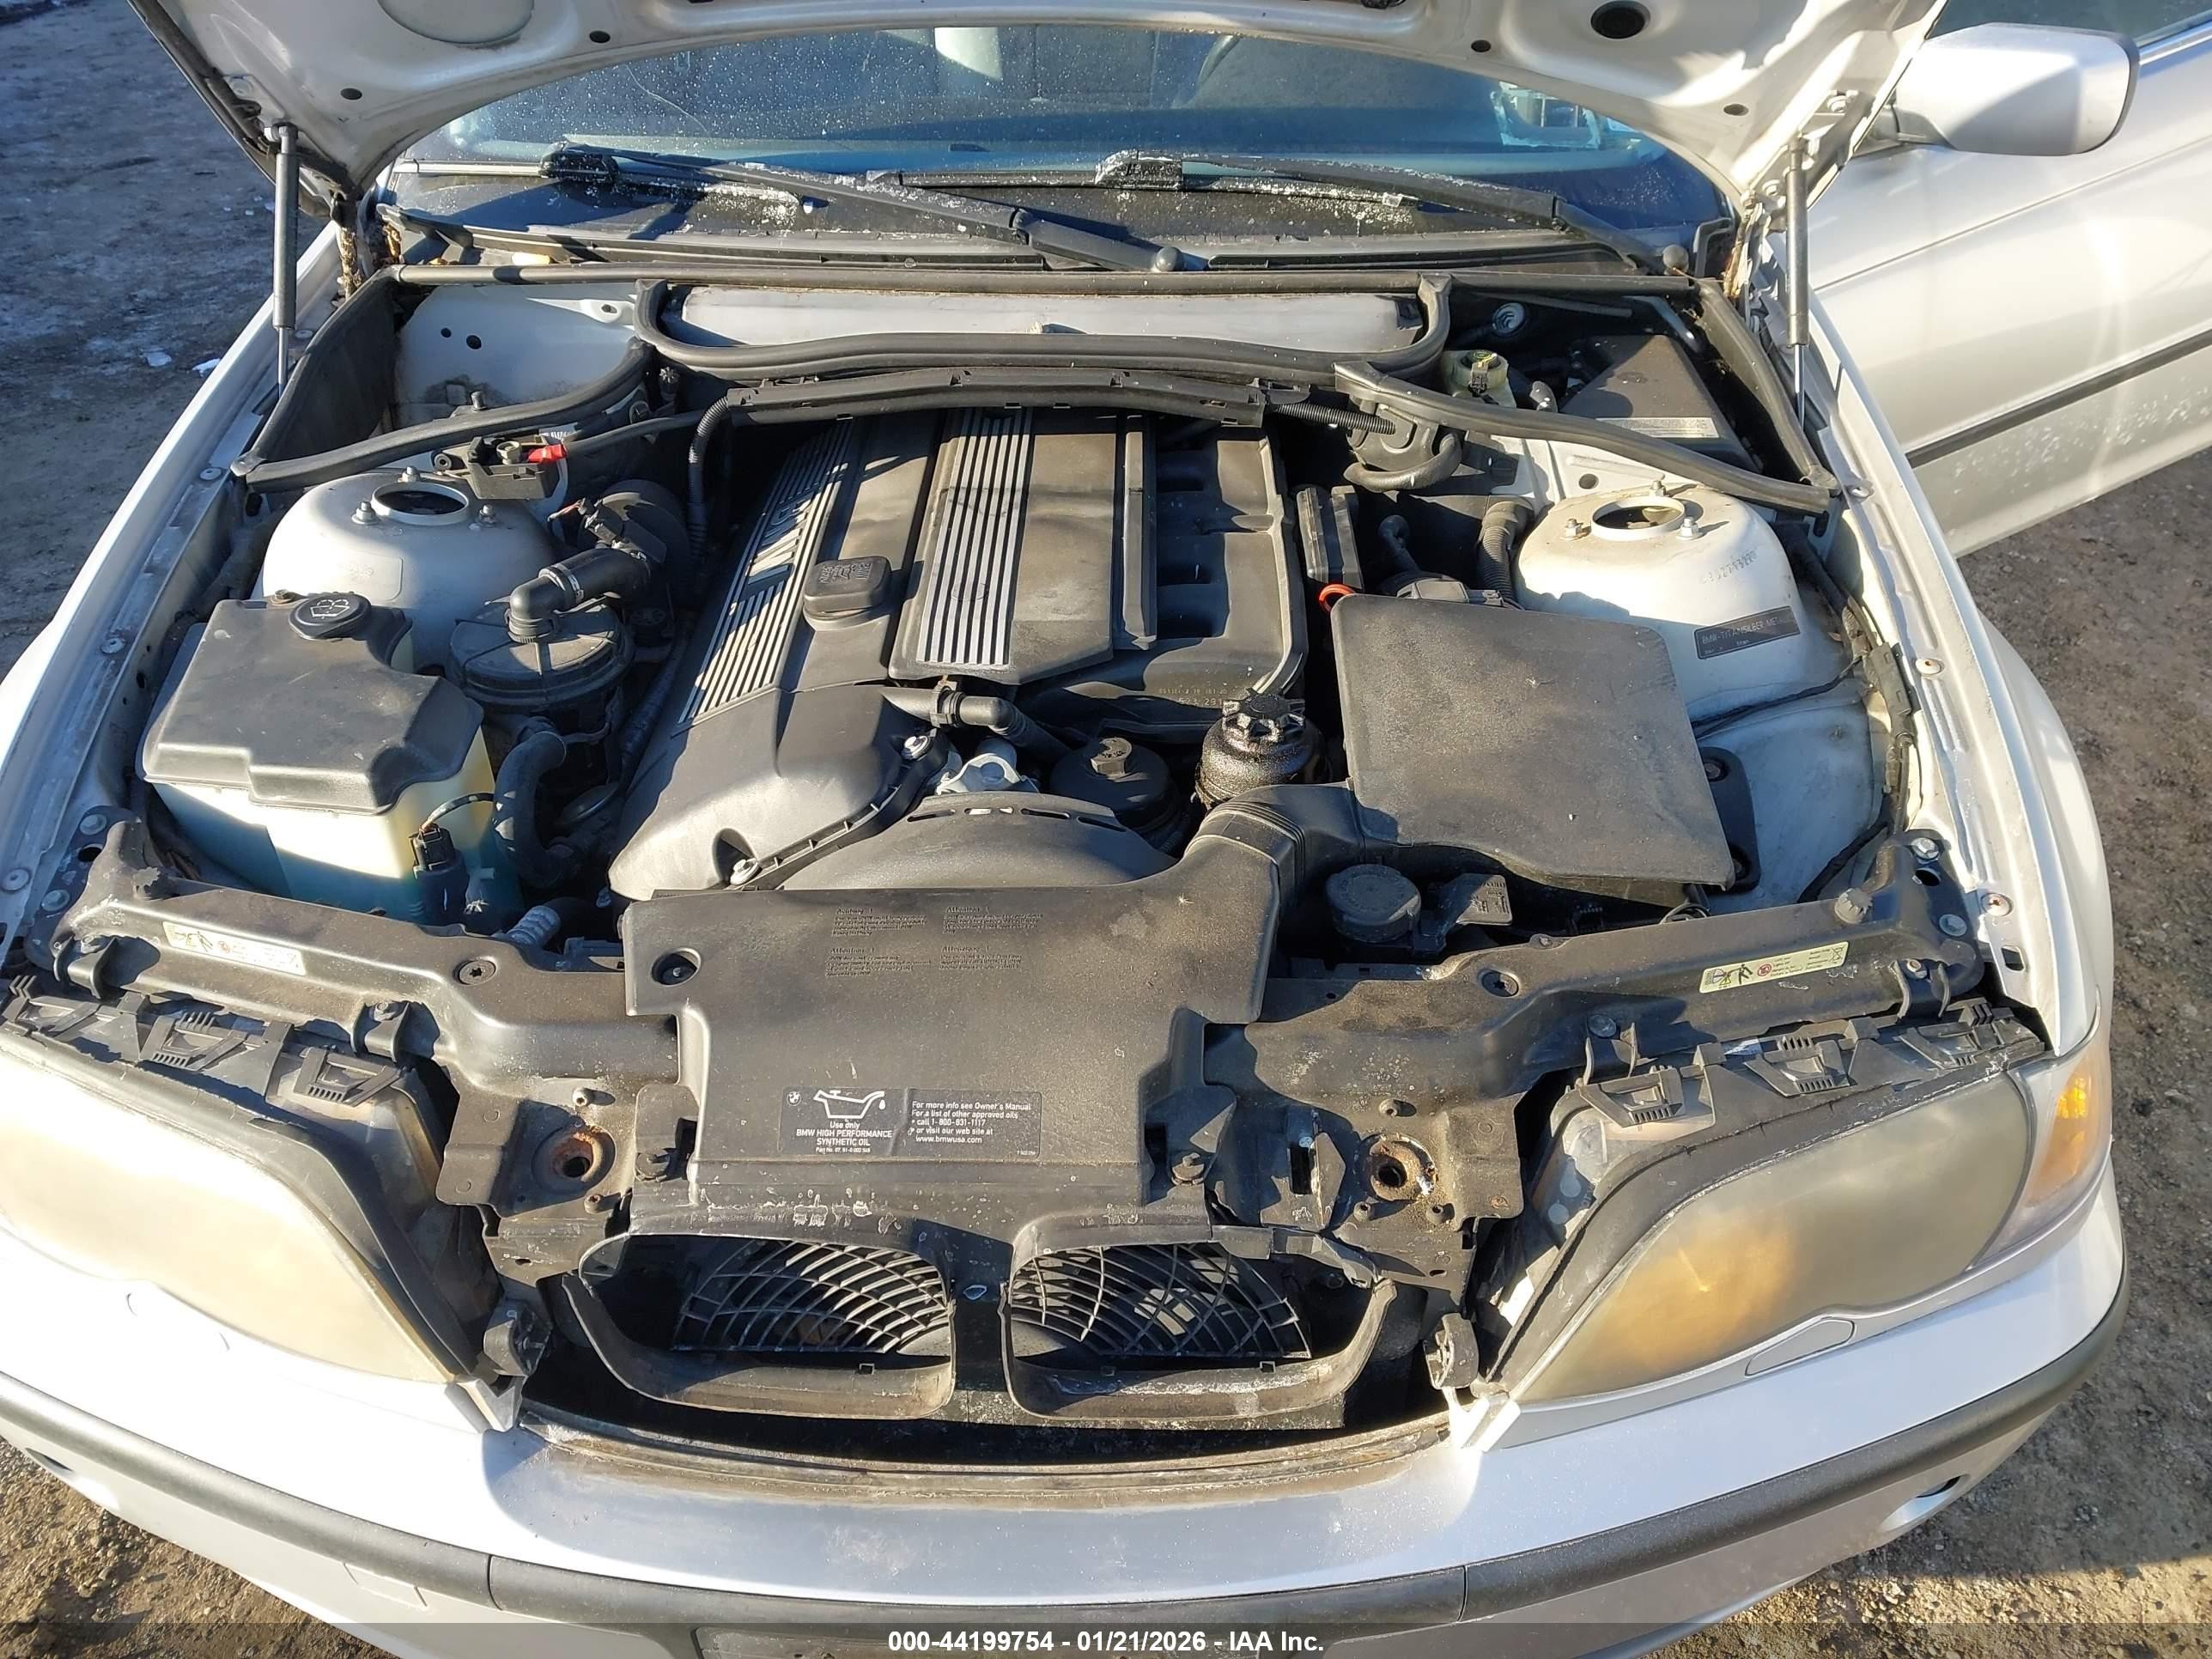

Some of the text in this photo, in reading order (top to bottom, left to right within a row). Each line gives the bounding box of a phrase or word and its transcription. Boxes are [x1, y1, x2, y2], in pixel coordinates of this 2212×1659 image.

[845, 1121, 860, 1130] only
[796, 1128, 814, 1137] BMW
[836, 1129, 893, 1138] PERFORMANCE
[859, 1138, 871, 1146] OIL
